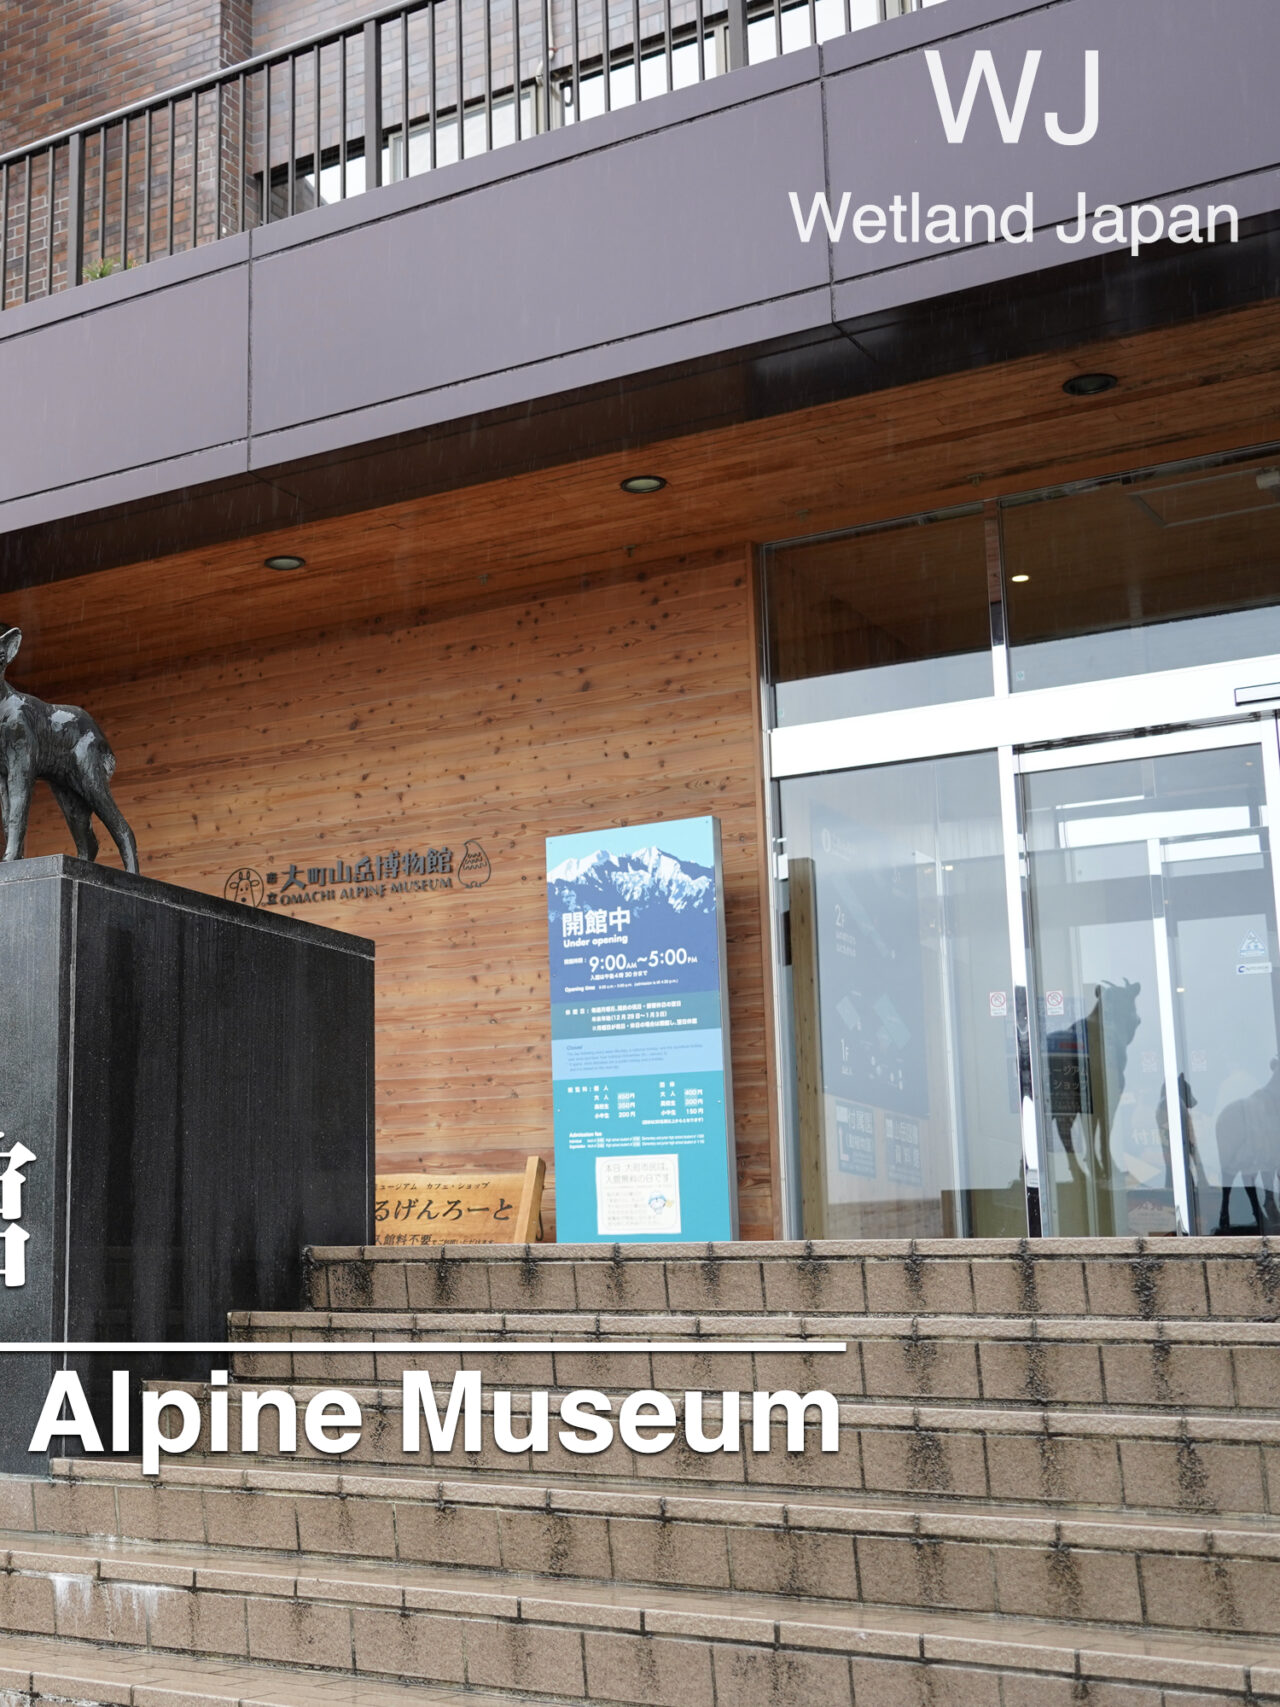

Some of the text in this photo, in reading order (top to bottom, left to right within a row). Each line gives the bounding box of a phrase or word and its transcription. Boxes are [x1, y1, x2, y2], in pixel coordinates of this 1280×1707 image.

[281, 846, 454, 893] 大町山岳博物館
[280, 877, 453, 906] OMACHI ALPINE MUSEUM
[562, 906, 631, 937] 開館中
[563, 935, 629, 949] Under opening
